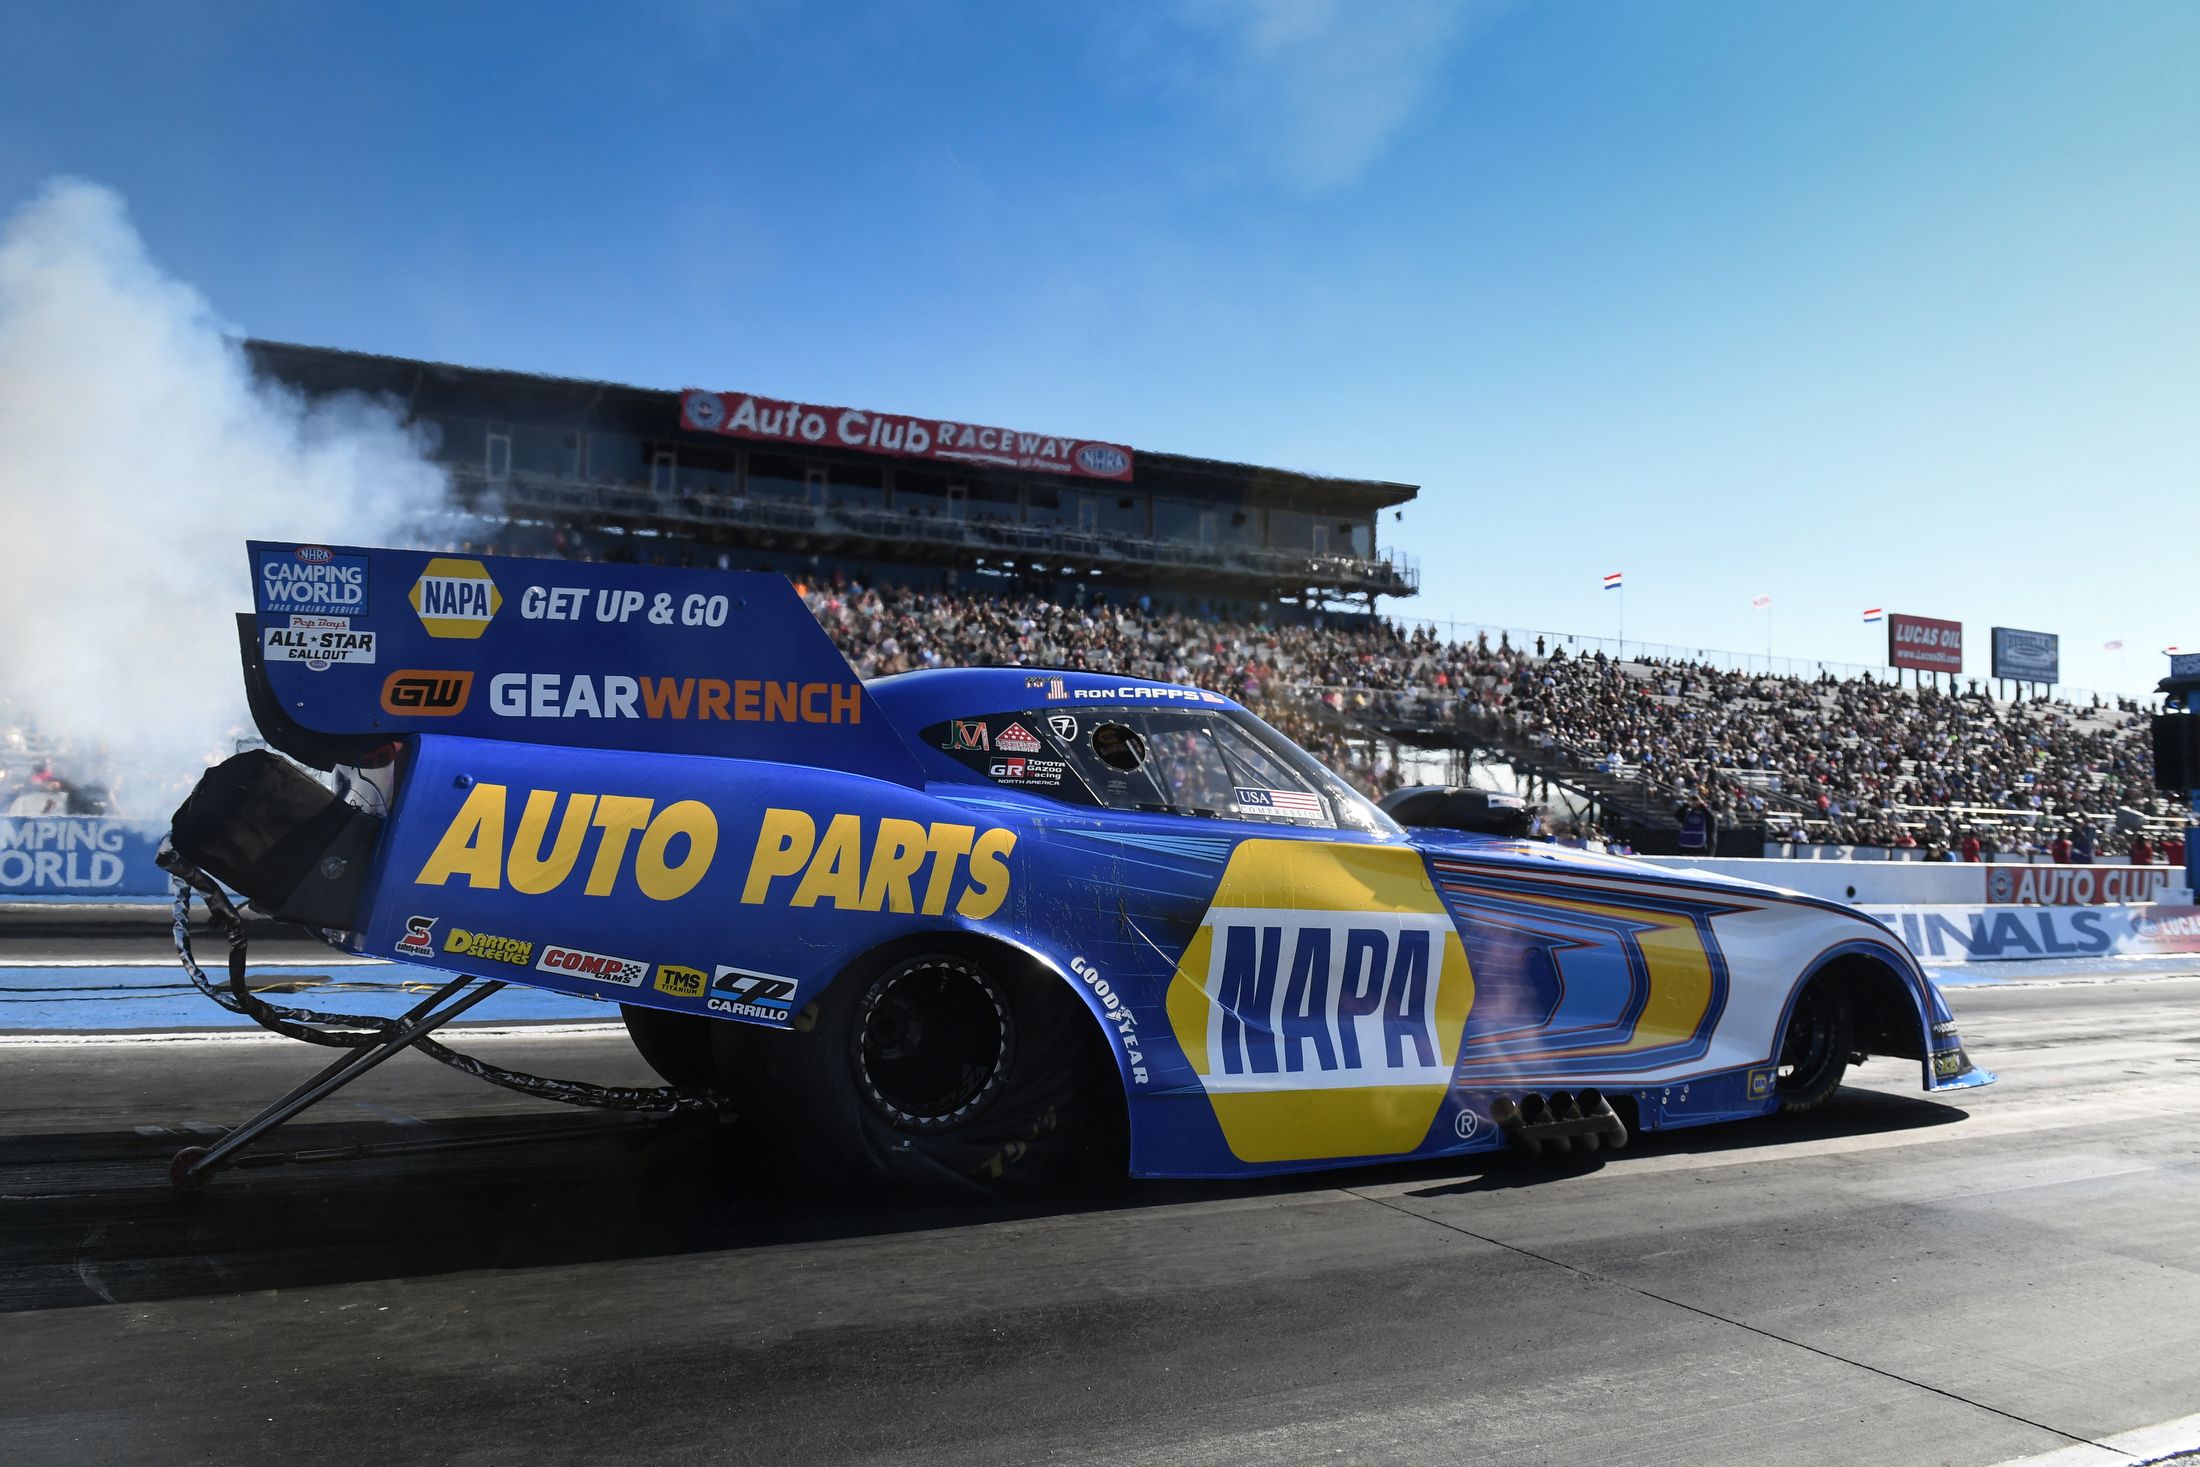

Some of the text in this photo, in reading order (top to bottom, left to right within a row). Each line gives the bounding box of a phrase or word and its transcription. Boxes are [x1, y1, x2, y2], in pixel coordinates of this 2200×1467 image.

[727, 396, 1076, 460] Auto Club RACEWAY
[1084, 449, 1123, 470] NHRA
[301, 549, 330, 561] NHRA
[263, 562, 363, 584] CAMPING
[264, 579, 363, 605] WORLD
[424, 581, 489, 617] NAPA
[267, 603, 360, 615] DRAG RACING SERIES
[520, 585, 729, 628] GET UP & GO
[293, 617, 348, 631] Pep Boys
[268, 630, 374, 650] ALL STAR
[1895, 623, 1961, 650] LUCAS OIL
[288, 648, 349, 661] CALLOUT
[489, 672, 861, 725] GEARWRENCH
[1074, 688, 1200, 701] RON CAPPS
[990, 764, 1023, 776] GR
[1027, 759, 1066, 767] TOYOTA
[1027, 765, 1062, 773] GAZOO
[1027, 771, 1061, 780] Racing
[1240, 791, 1270, 804] USA
[1241, 805, 1323, 819] COMPRESSION
[414, 783, 1018, 920] AUTO PARTS
[2016, 868, 2095, 904] AUTO
[443, 928, 534, 955] DARTON
[467, 945, 530, 966] SLEEVES
[544, 949, 624, 975] COMP
[594, 972, 631, 984] CAMS
[663, 968, 700, 989] TMS
[661, 983, 698, 995] TITANIUM
[707, 998, 789, 1021] CARRILLO
[1221, 925, 1437, 1075] NAPA
[1070, 957, 1149, 1085] GOODYEAR
